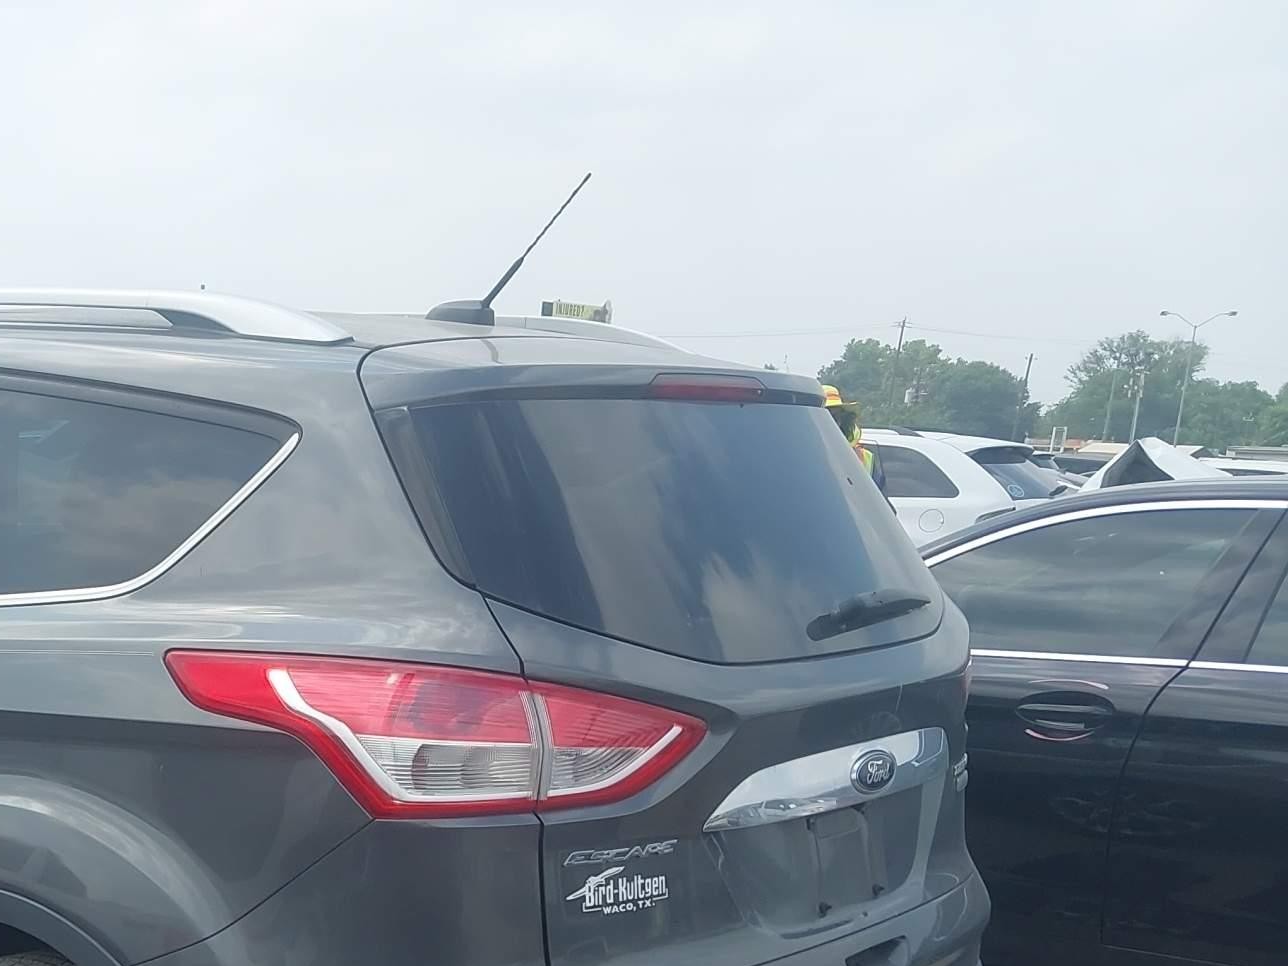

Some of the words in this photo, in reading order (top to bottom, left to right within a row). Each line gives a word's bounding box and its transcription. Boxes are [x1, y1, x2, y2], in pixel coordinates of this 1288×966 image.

[555, 303, 585, 317] INJURED?
[866, 759, 891, 785] Ford
[562, 839, 678, 867] ESCAPE
[584, 875, 666, 907] Bird-Kultgen
[602, 902, 637, 914] WACO,
[637, 898, 656, 909] TX.
